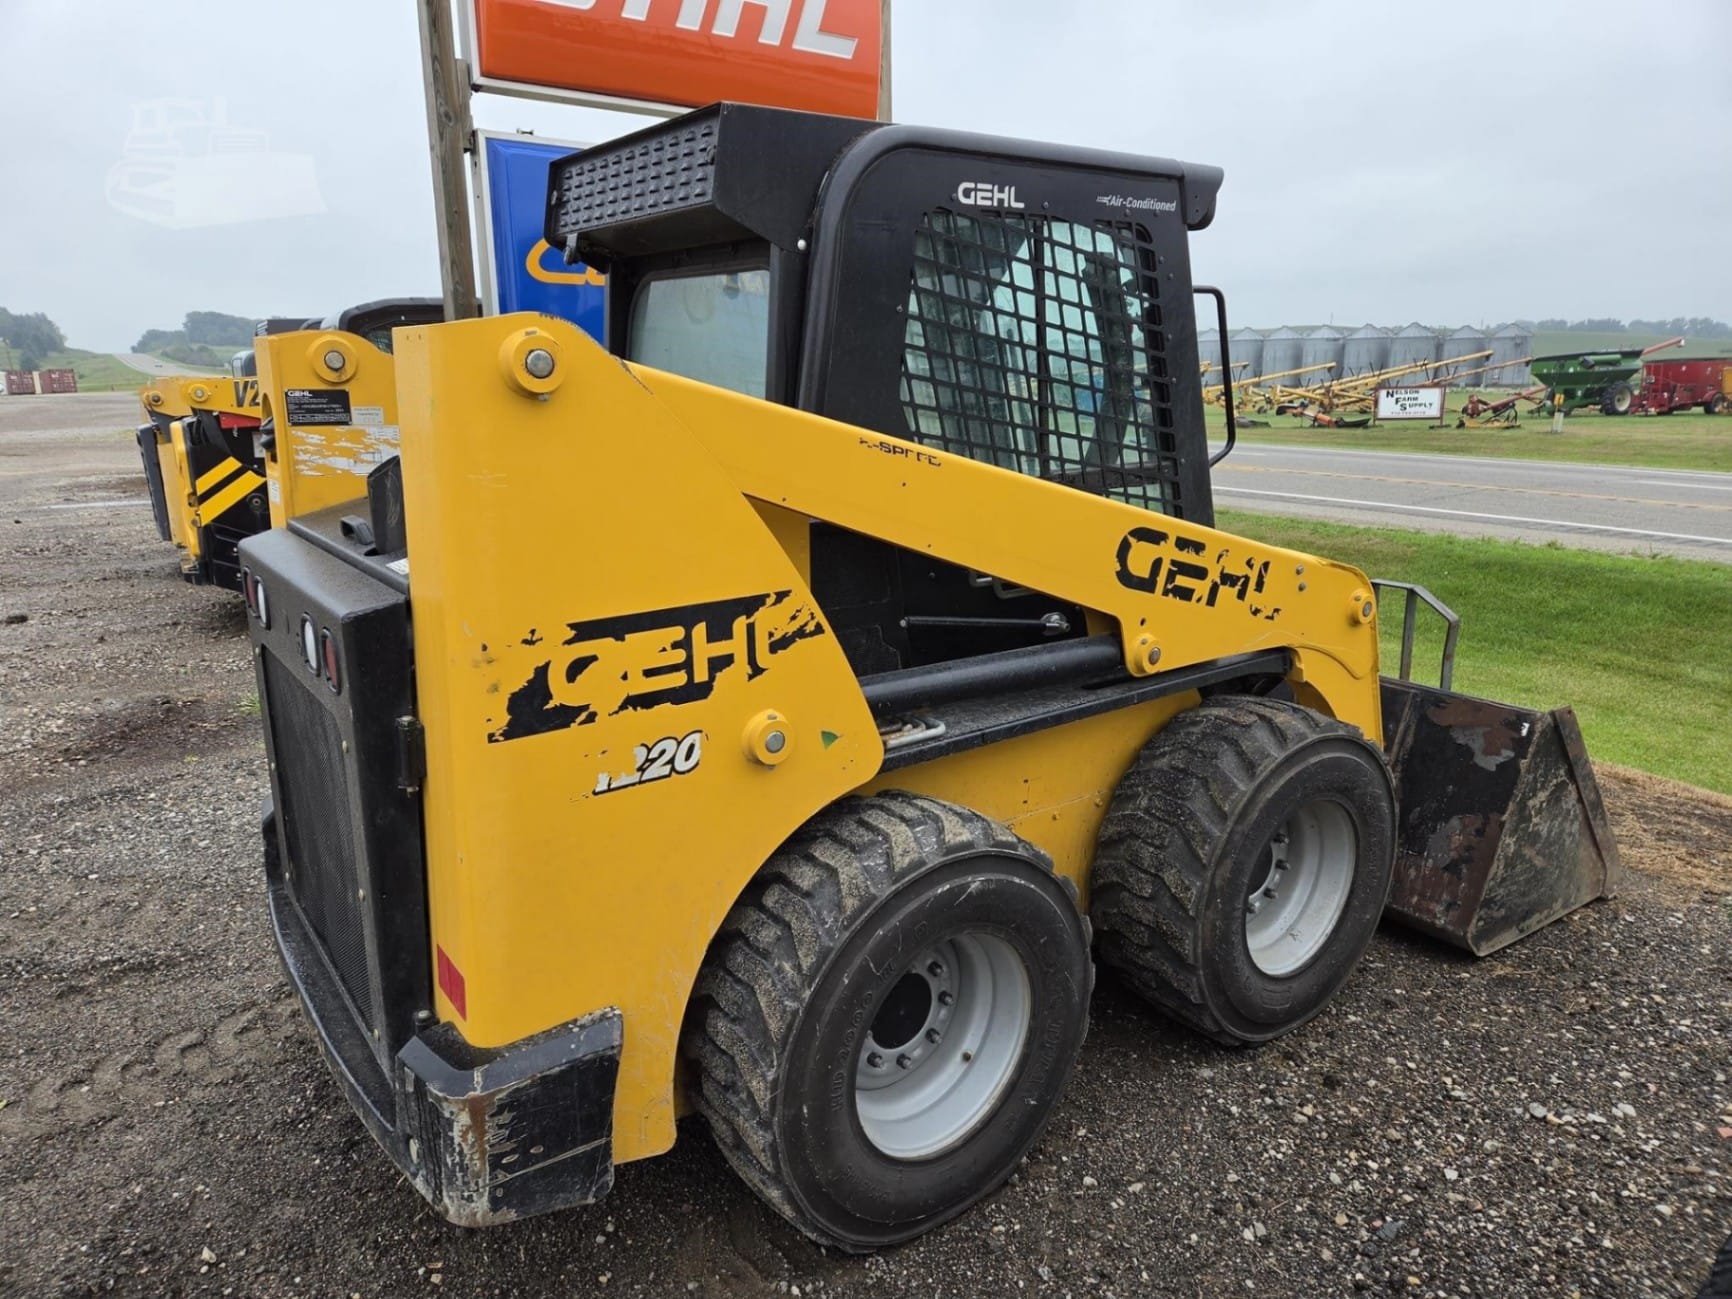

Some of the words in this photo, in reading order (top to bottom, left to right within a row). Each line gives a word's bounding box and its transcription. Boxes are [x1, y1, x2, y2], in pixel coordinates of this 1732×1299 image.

[957, 181, 1025, 209] GEHL
[1109, 196, 1176, 211] Air-Conditioned
[1386, 389, 1419, 398] NELSON
[1395, 396, 1419, 405] FARM
[1399, 402, 1433, 411] SUPPLY
